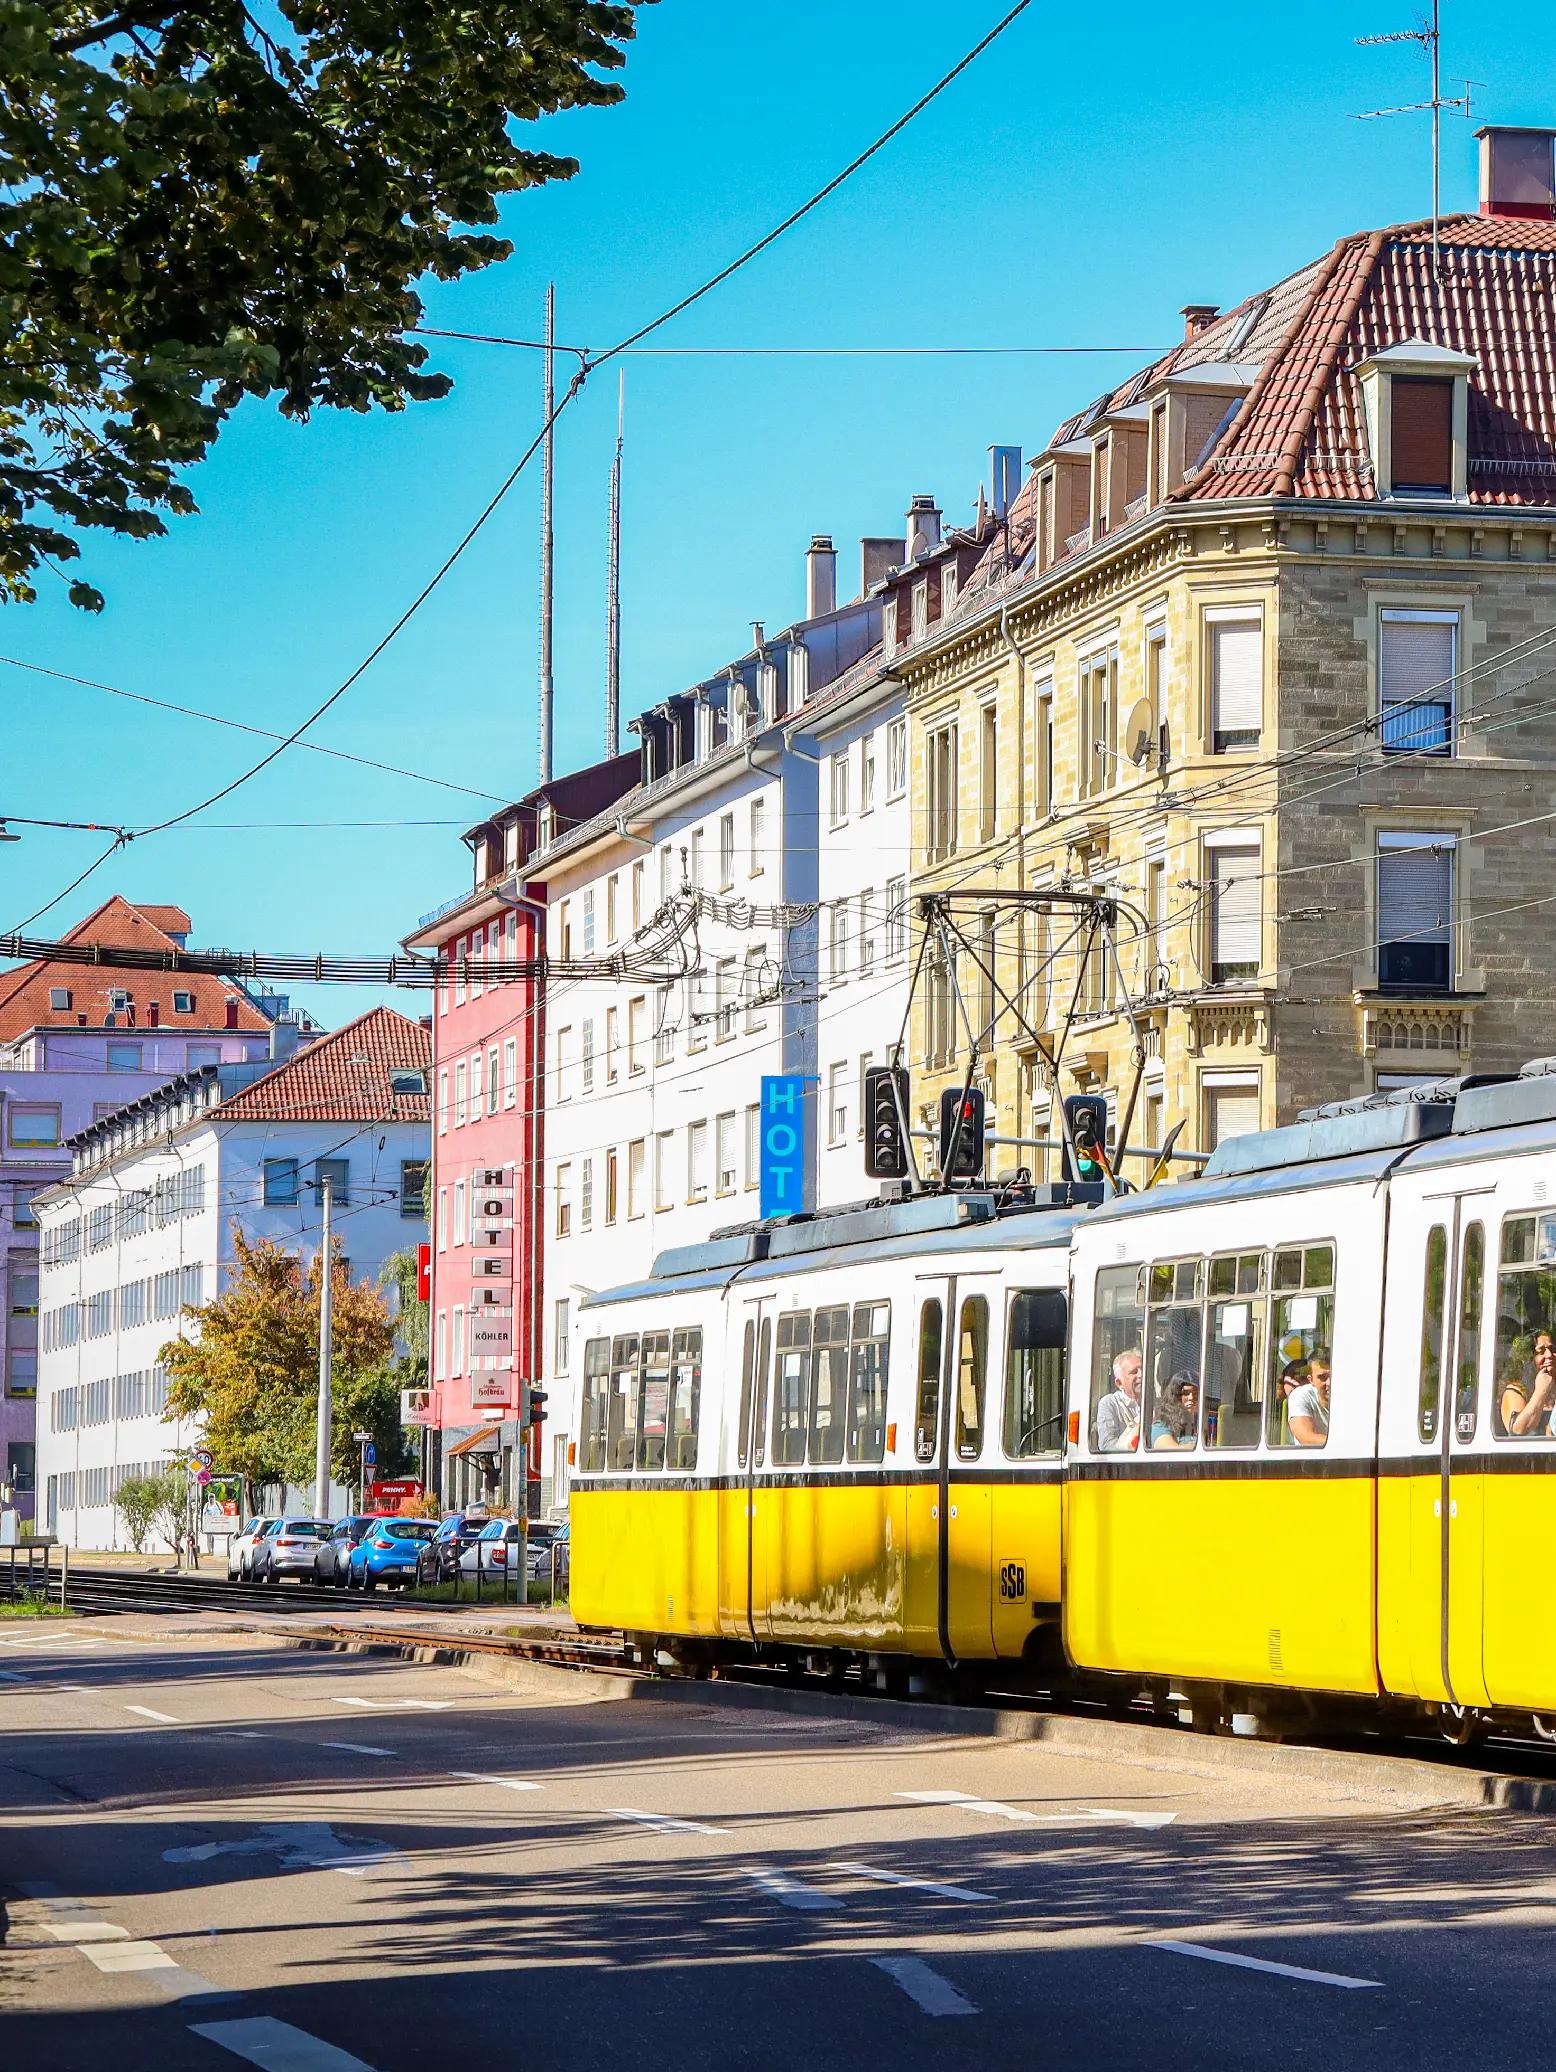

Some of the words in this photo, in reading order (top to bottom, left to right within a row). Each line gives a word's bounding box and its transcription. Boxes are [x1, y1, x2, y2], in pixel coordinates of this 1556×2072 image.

[483, 1170, 504, 1304] HOTEL
[475, 1331, 508, 1340] KÖHLER
[1001, 1563, 1024, 1599] SSB
